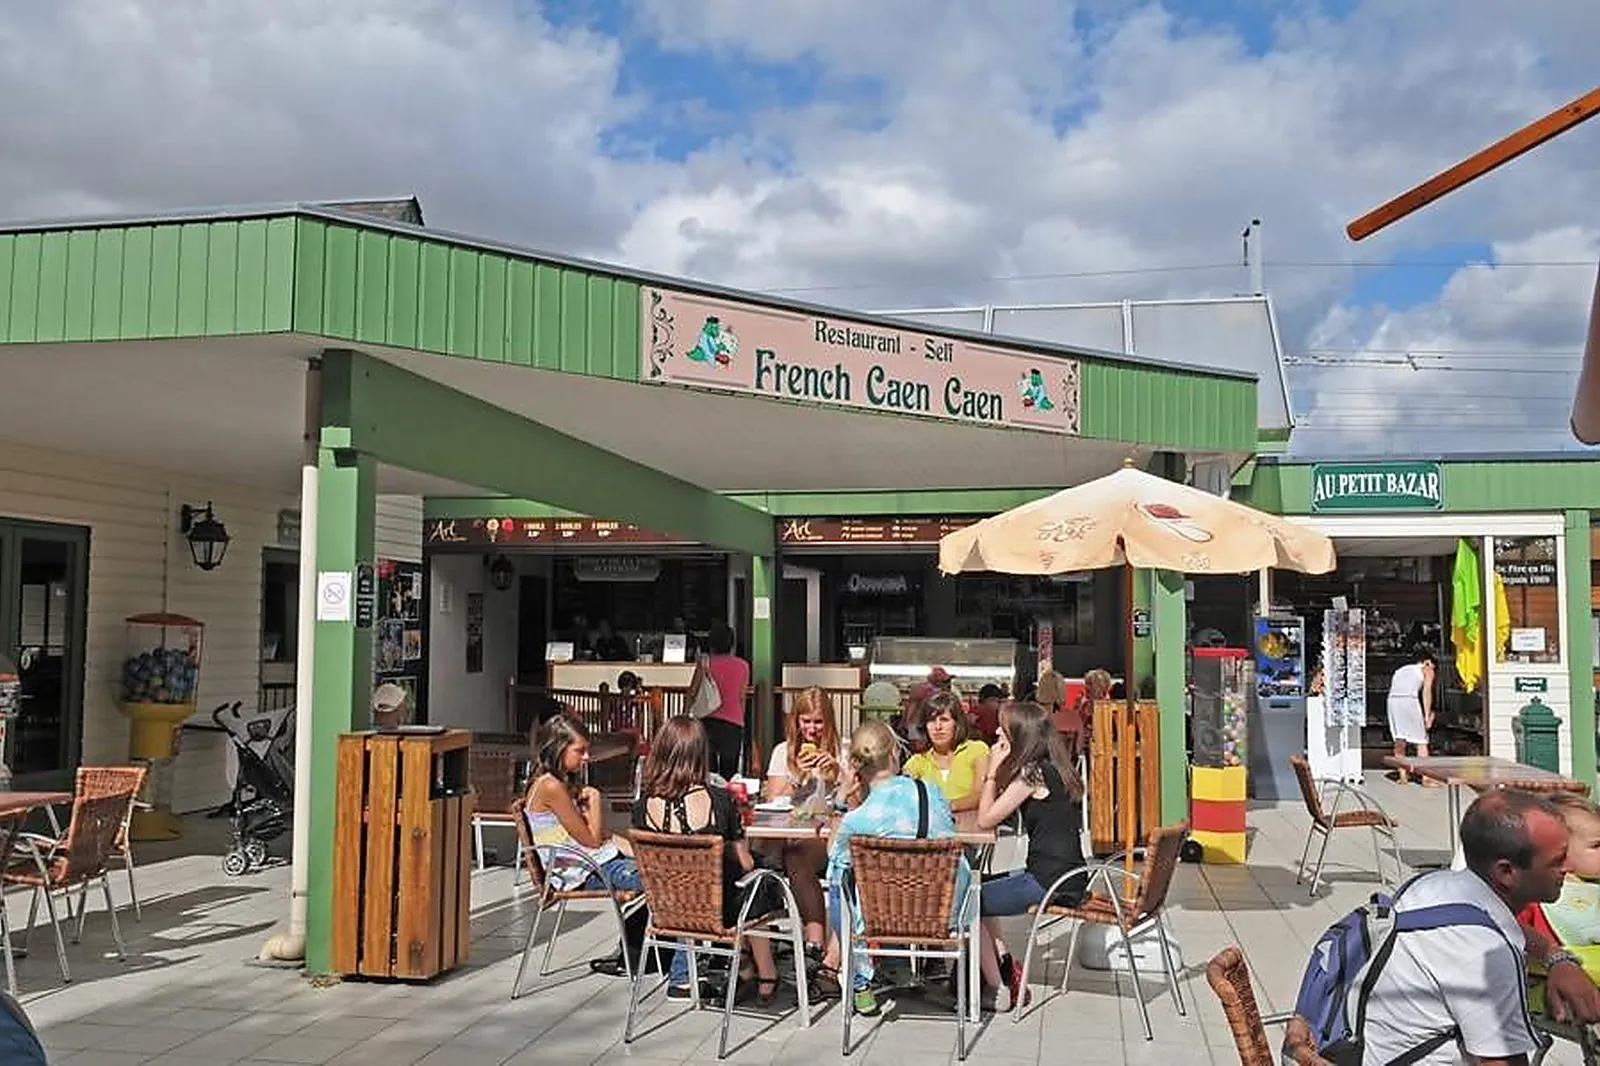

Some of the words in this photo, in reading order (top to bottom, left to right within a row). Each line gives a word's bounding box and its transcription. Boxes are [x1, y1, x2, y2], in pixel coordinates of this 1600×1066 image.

[815, 320, 901, 354] Restaurant
[924, 338, 954, 363] Self
[755, 349, 850, 401] French
[867, 365, 930, 411] Caen
[944, 377, 1003, 421] Caen
[1314, 474, 1336, 502] AU
[1339, 473, 1384, 496] PETIT
[1387, 473, 1439, 501] BAZAR
